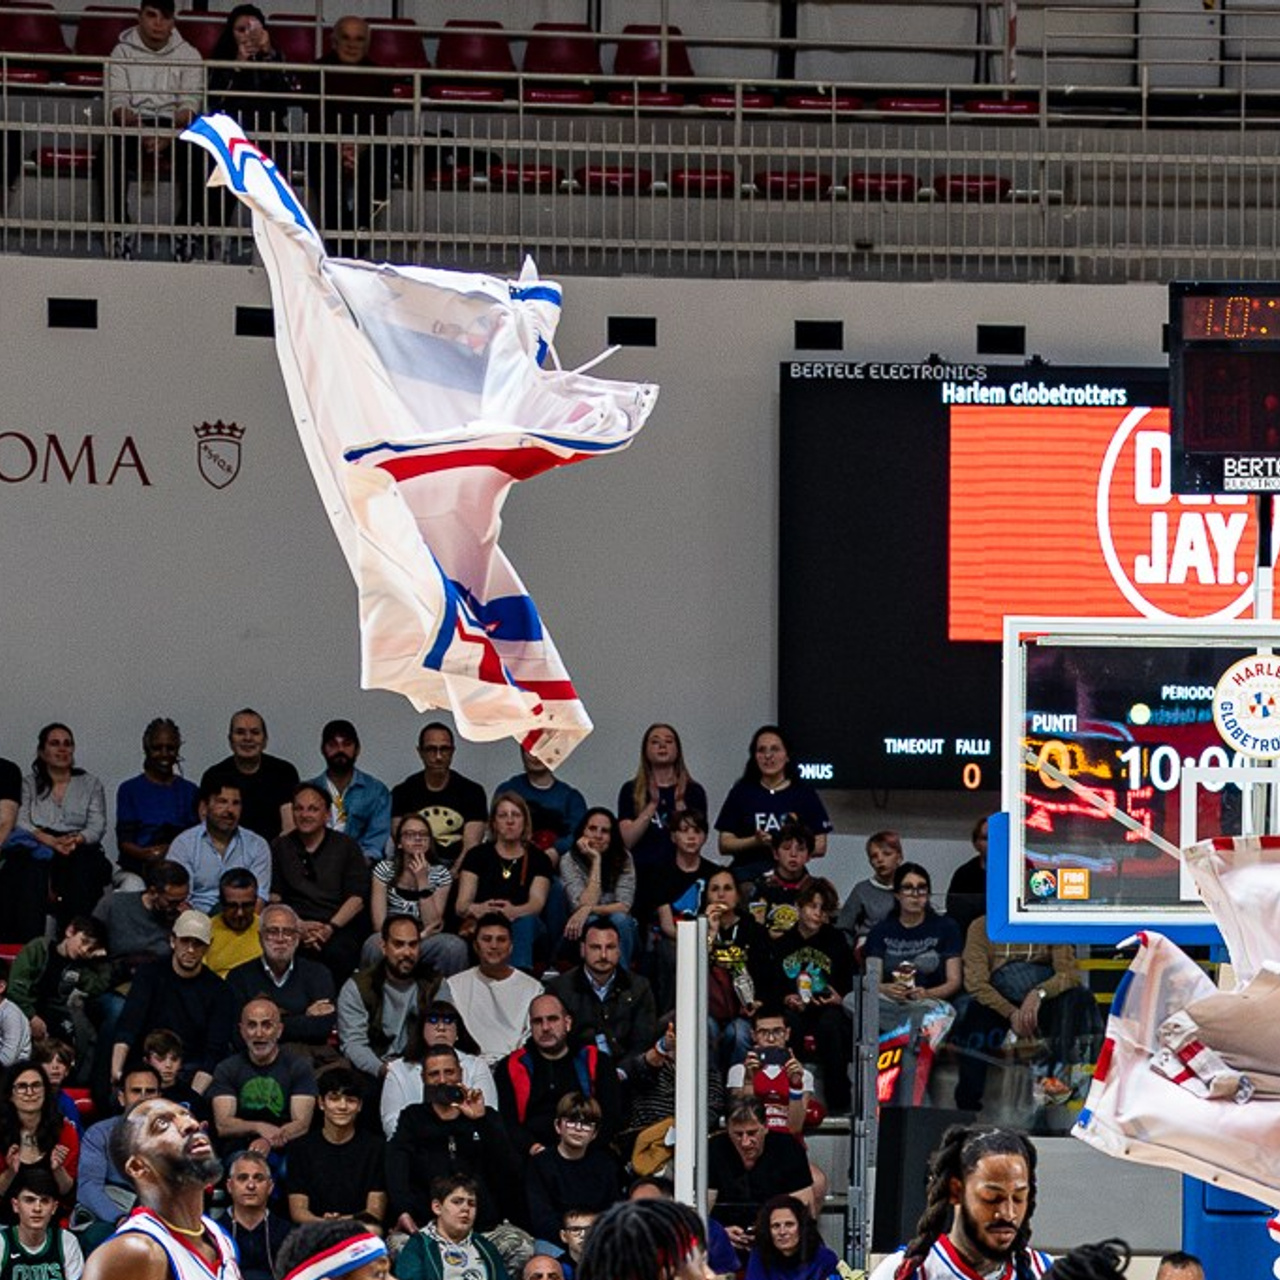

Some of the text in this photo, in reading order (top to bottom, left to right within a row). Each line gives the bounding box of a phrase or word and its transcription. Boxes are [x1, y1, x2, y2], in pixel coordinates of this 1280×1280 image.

[870, 365, 987, 381] ELECTRONICS
[943, 382, 1005, 404] Harlem
[1010, 382, 1127, 405] Globetrotters
[1162, 686, 1214, 700] PERIODO
[1032, 714, 1077, 732] PUNTI
[884, 738, 991, 755] TIMEOUT FALLI
[798, 763, 833, 780] ONUS
[963, 762, 982, 789] 0
